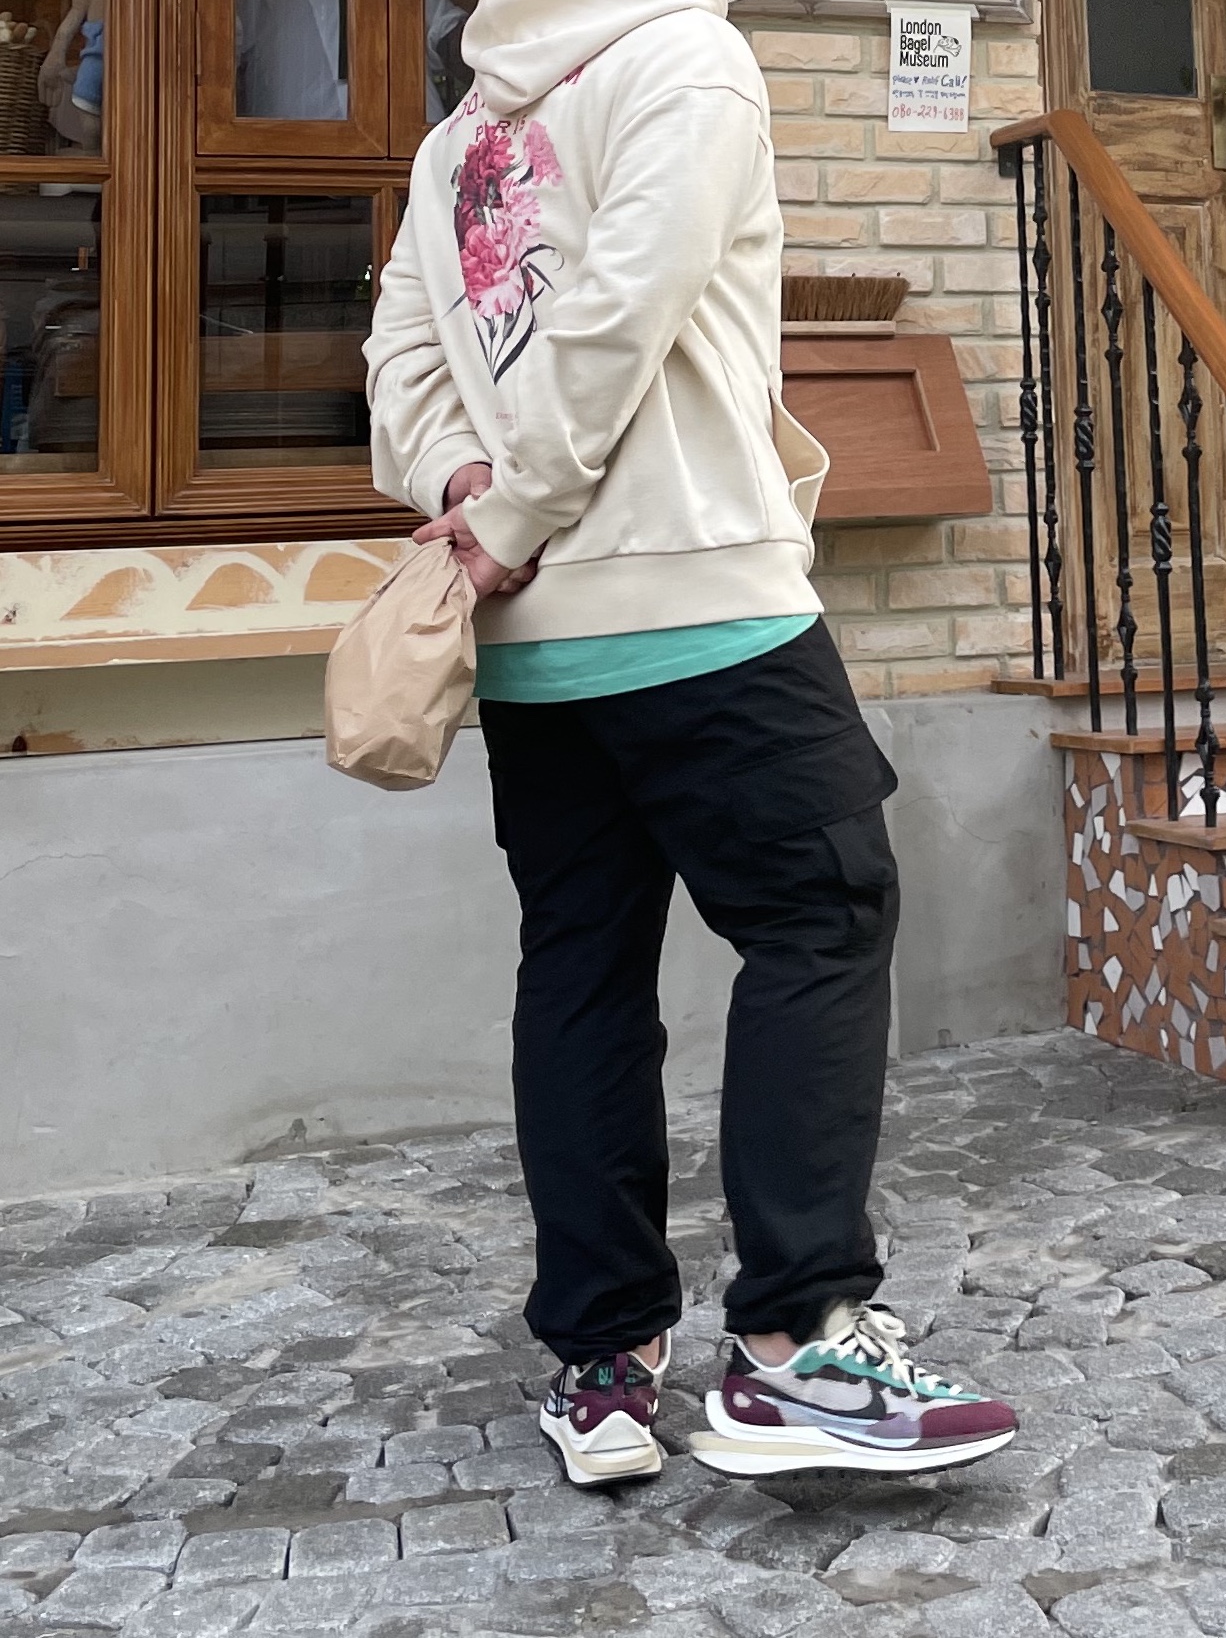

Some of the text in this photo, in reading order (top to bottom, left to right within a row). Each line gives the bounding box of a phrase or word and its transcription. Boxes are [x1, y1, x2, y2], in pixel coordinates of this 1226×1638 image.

[900, 18, 941, 35] London
[900, 34, 931, 54] Bagel
[900, 51, 949, 68] Museum
